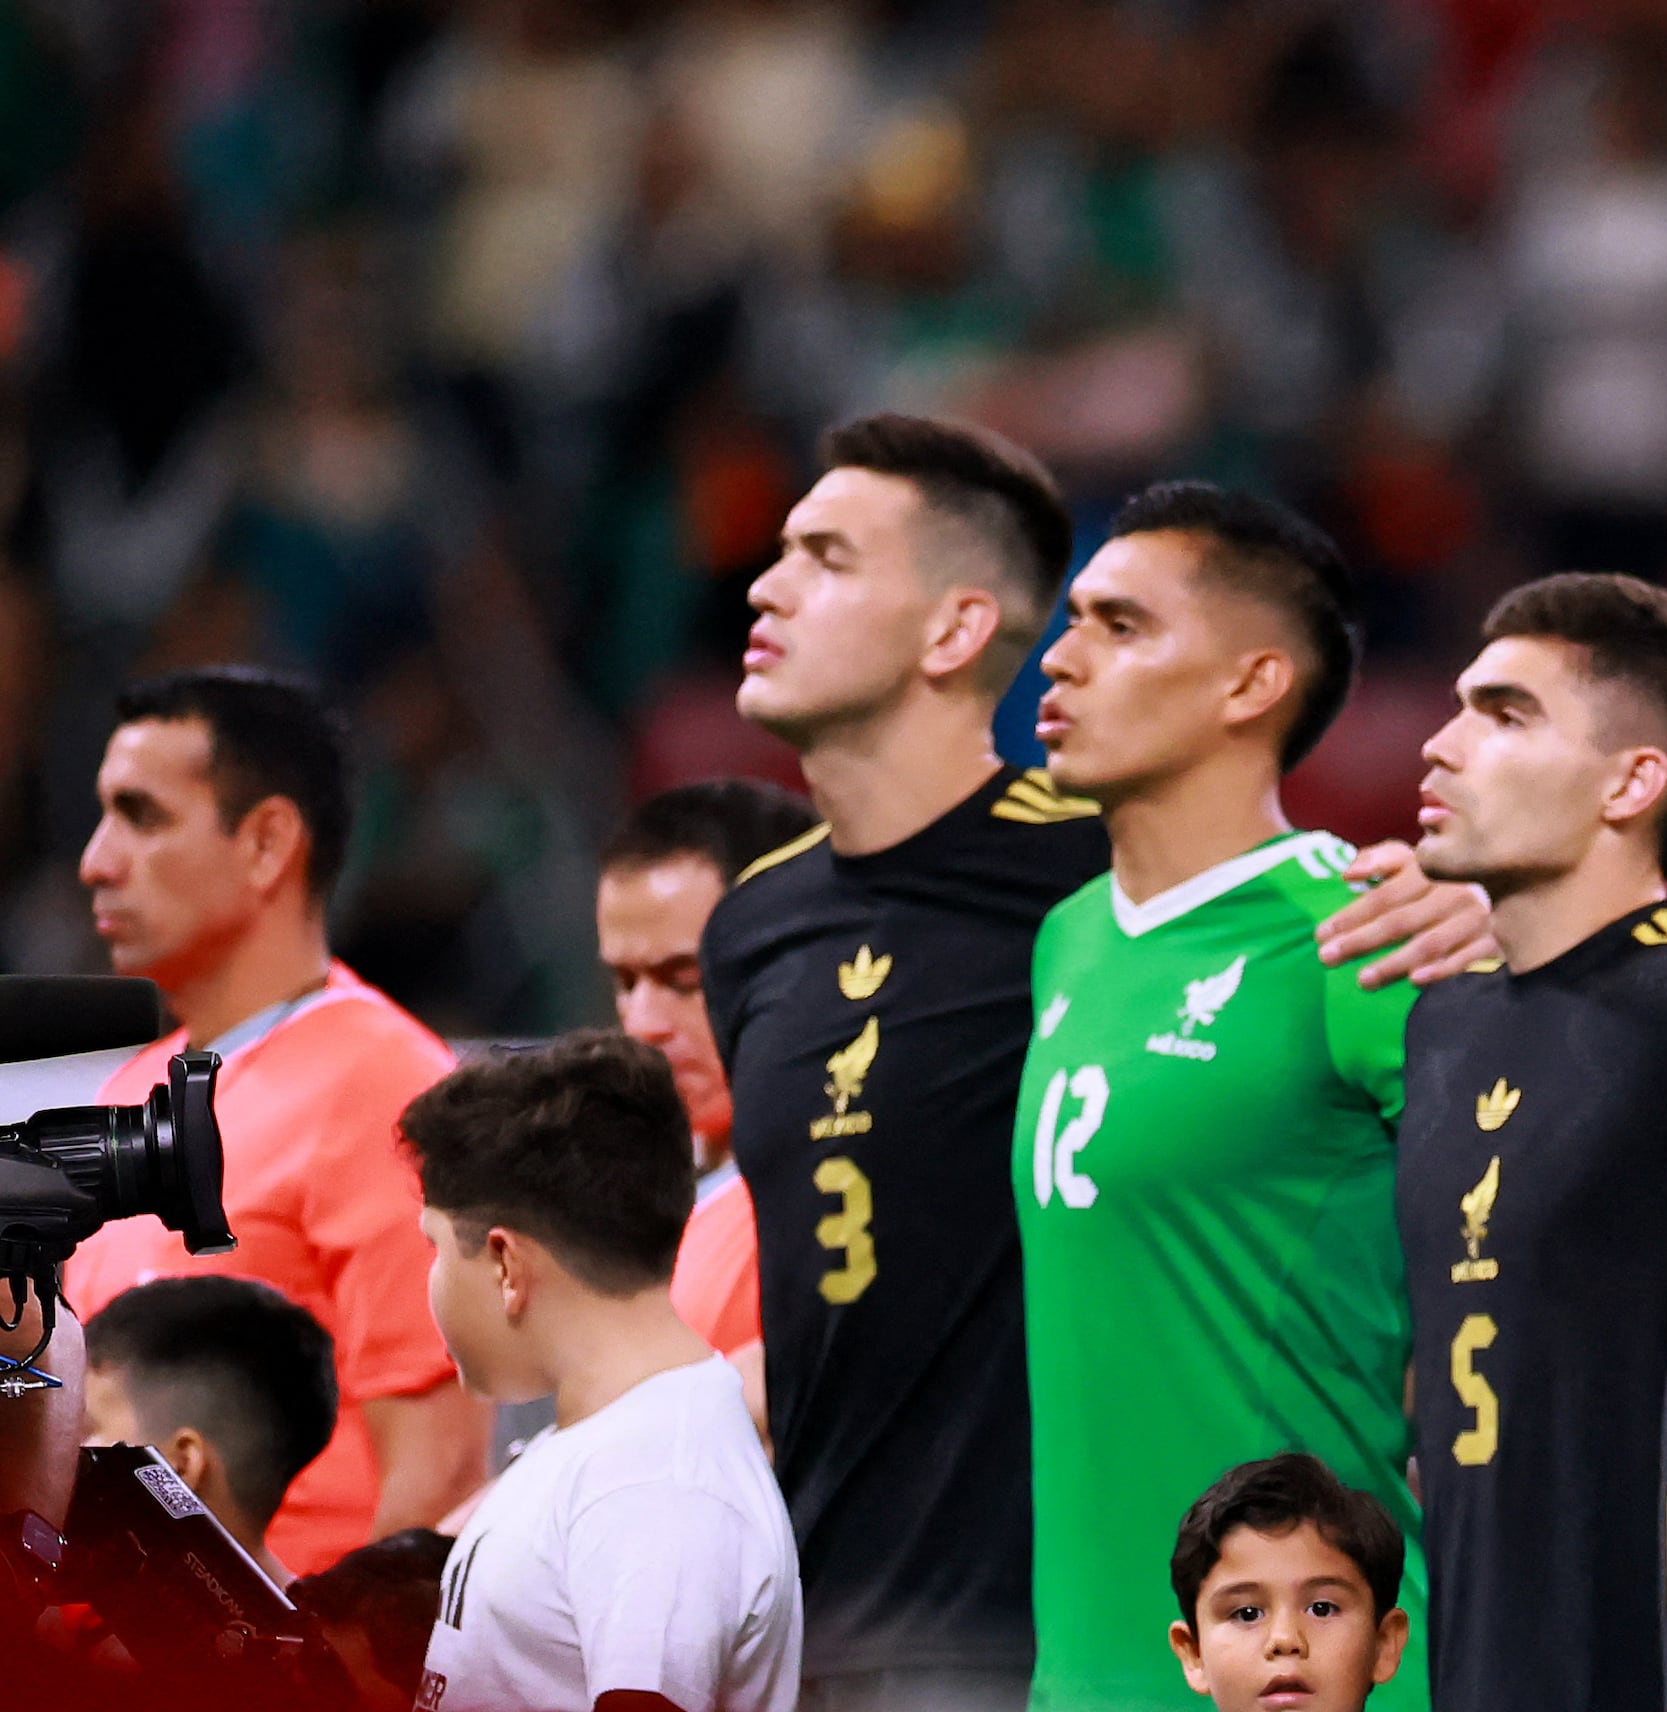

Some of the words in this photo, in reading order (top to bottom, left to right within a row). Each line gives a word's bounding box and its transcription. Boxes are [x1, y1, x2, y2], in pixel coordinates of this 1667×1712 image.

[1033, 1064, 1110, 1209] 12
[813, 1156, 877, 1304] 3
[1451, 1313, 1499, 1467] 5
